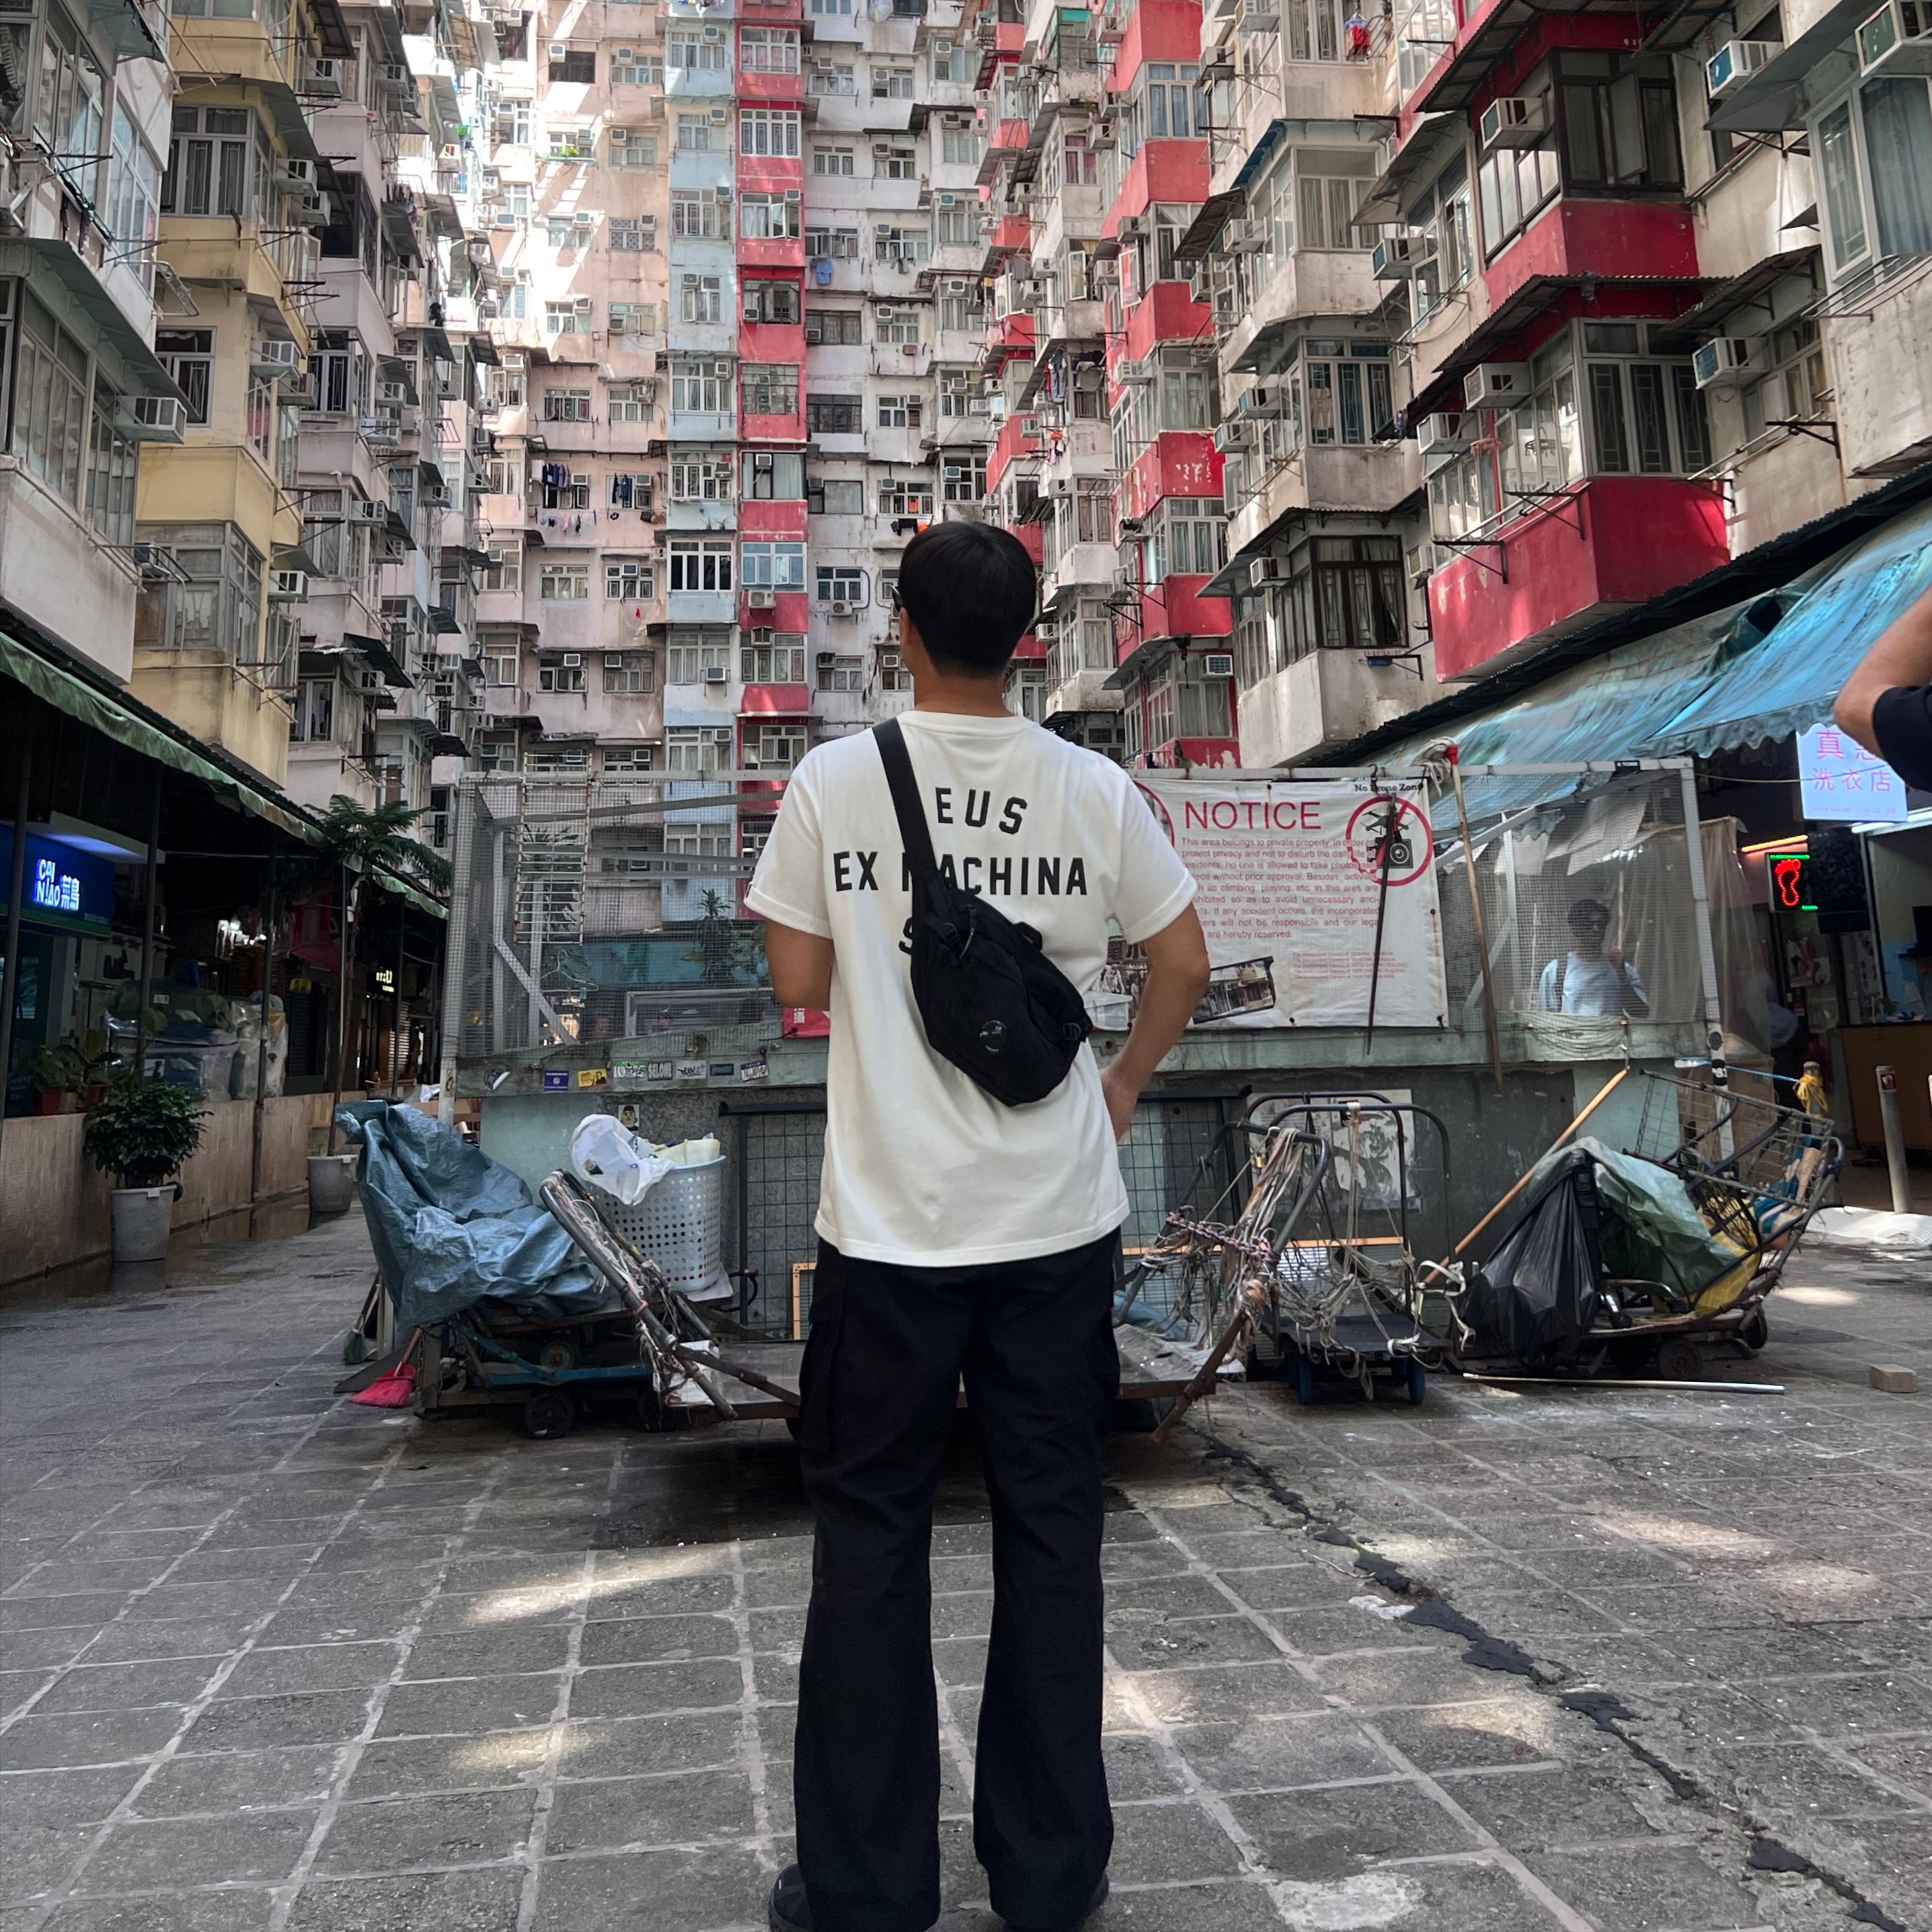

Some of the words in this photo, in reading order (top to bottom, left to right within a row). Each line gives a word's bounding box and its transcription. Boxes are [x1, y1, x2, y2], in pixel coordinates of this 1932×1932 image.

[1812, 768, 1891, 792] 洗衣店
[1399, 783, 1418, 791] Zon
[935, 787, 1028, 835] EUS
[1185, 801, 1321, 830] NOTICE
[1182, 838, 1198, 846] This
[1223, 839, 1255, 848] belongs
[1267, 839, 1293, 847] private
[1213, 851, 1242, 859] privacy
[1332, 850, 1350, 859] daily
[1366, 849, 1377, 857] of
[1331, 861, 1357, 871] photos
[833, 851, 879, 892] EX
[1245, 874, 1264, 882] prior
[1303, 896, 1354, 904] unnecessary
[1222, 909, 1237, 917] any
[1272, 919, 1319, 927] responsible
[1361, 919, 1379, 927] lega
[1223, 931, 1251, 939] hereby
